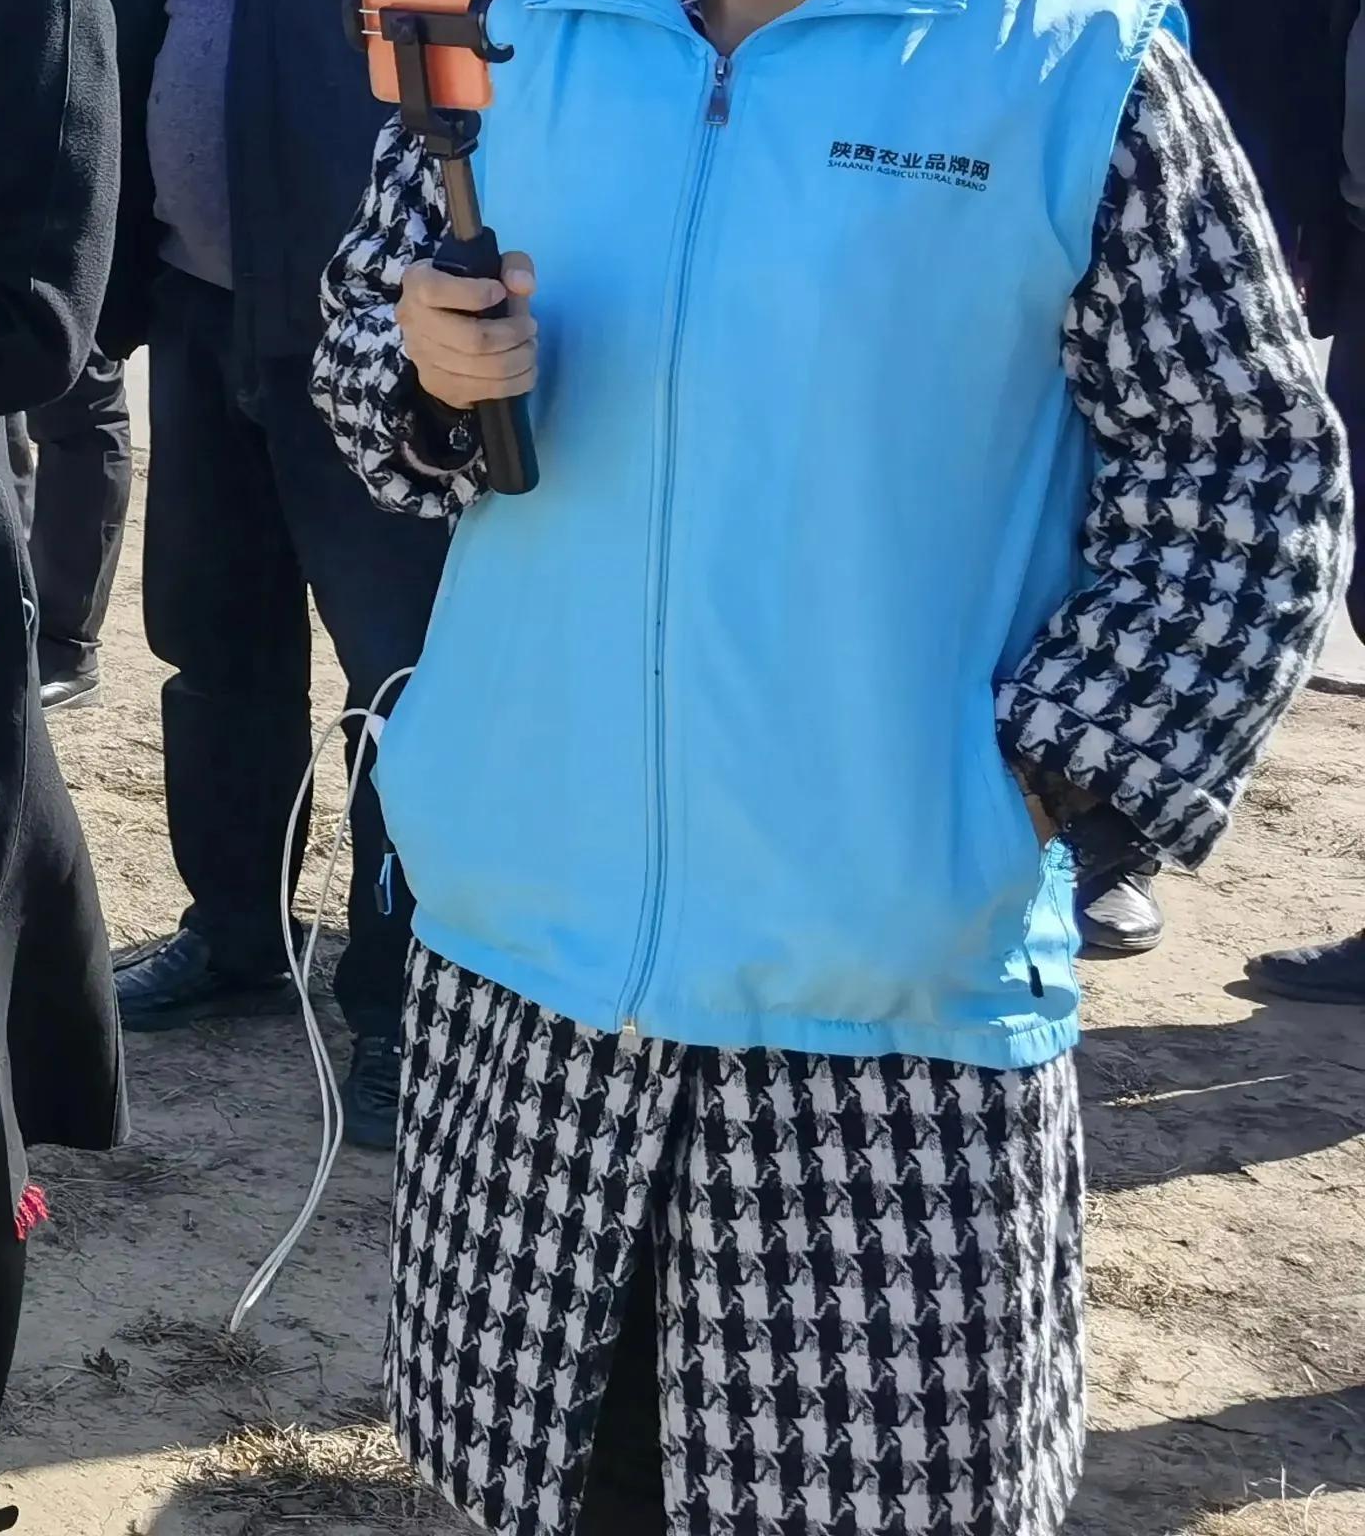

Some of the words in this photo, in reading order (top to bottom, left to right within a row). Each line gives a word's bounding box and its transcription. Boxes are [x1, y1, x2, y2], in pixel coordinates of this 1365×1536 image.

[827, 158, 873, 172] SHAANXI
[876, 166, 952, 185] AGRICULTURAL
[955, 177, 987, 193] BRAND
[829, 140, 991, 182] 陕西农业品牌网
